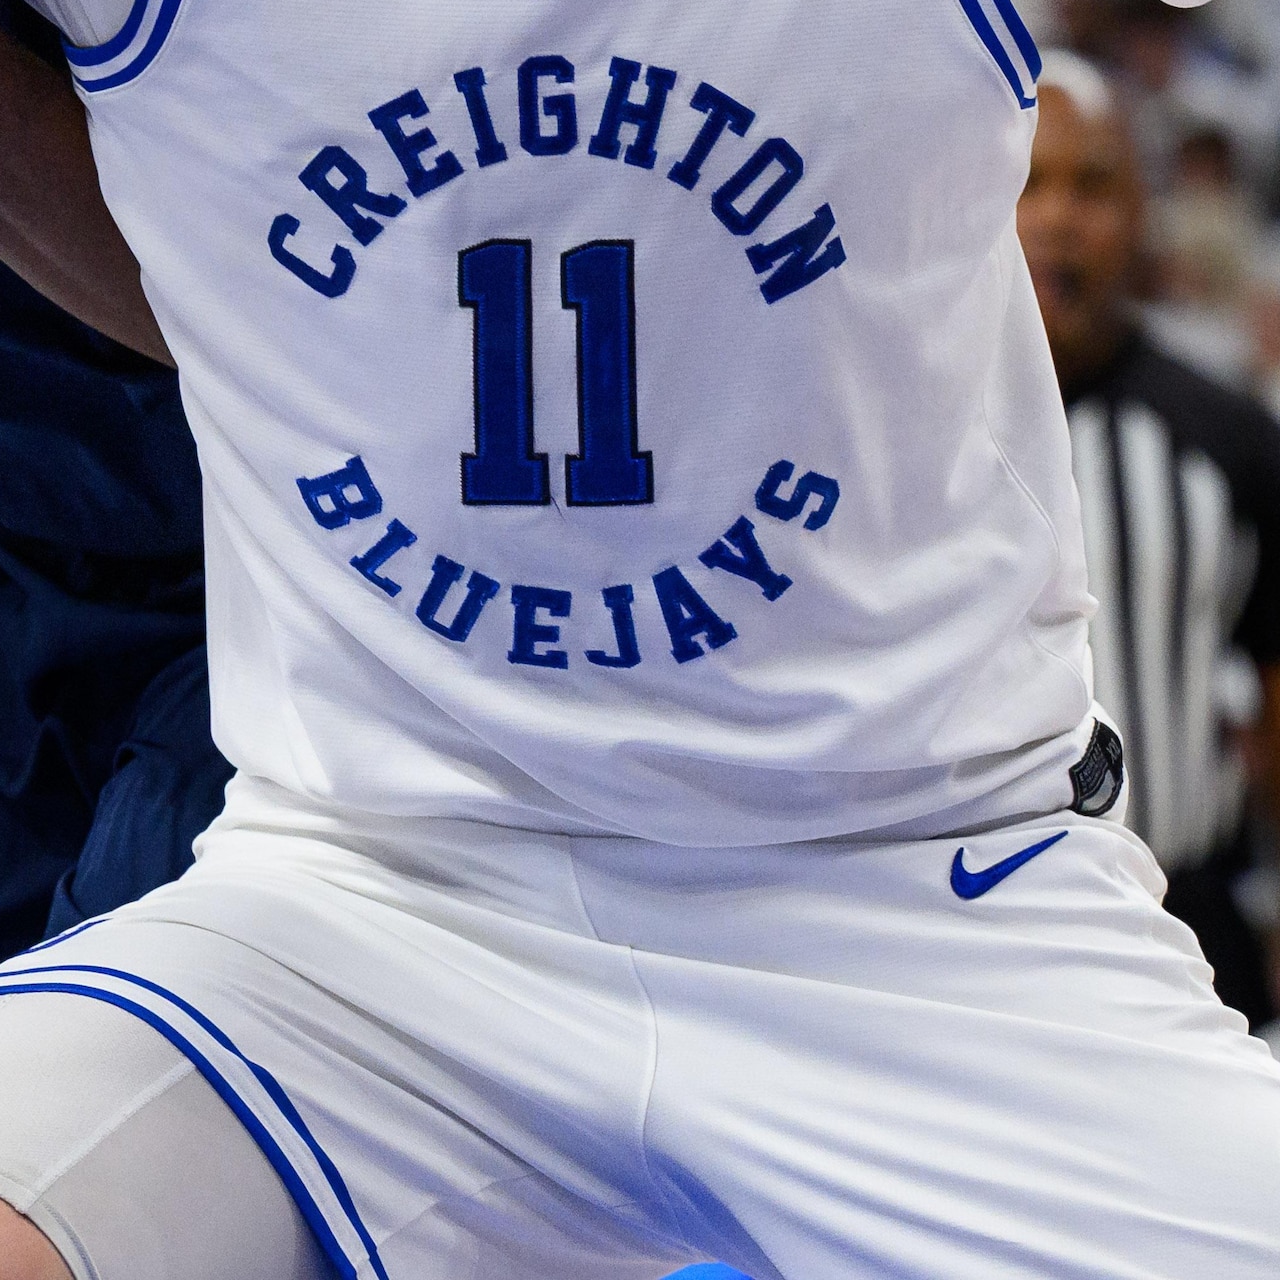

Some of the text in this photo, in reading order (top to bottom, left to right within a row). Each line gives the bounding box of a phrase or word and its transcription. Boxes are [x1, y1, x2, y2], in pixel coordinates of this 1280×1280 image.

[267, 54, 847, 304] CREIGHTON
[457, 237, 654, 507] 11
[295, 454, 841, 670] BLUEJAYS
